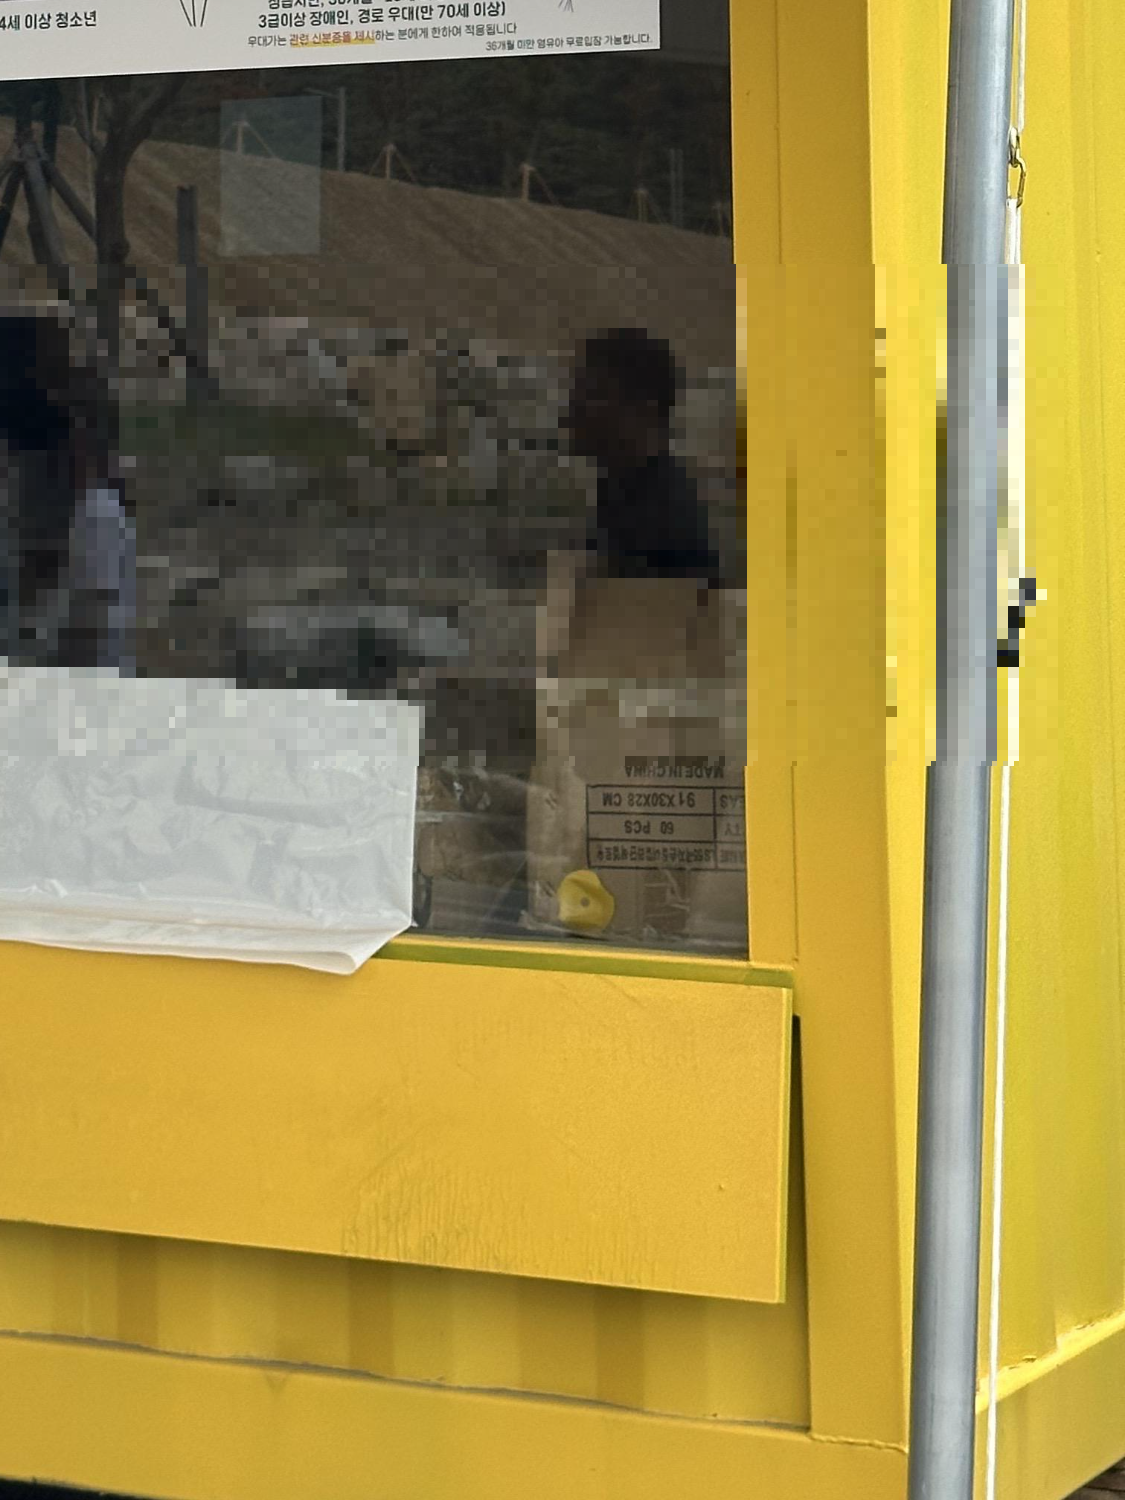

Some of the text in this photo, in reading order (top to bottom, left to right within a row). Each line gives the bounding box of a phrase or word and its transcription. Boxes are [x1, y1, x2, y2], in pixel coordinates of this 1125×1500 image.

[25, 13, 52, 30] 이상
[55, 10, 97, 29] 청소년
[258, 0, 507, 28] 3급이상 장애인, 경로 우대(만 70세 이상)
[248, 22, 517, 47] 우대가는 관련 신분증을 제시하는 분에게 한하여 적용됩니다
[485, 40, 515, 51] 36개월
[516, 39, 535, 50] 미만
[603, 792, 622, 806] CM
[627, 792, 695, 808] 91X30X28
[624, 820, 651, 834] PCS
